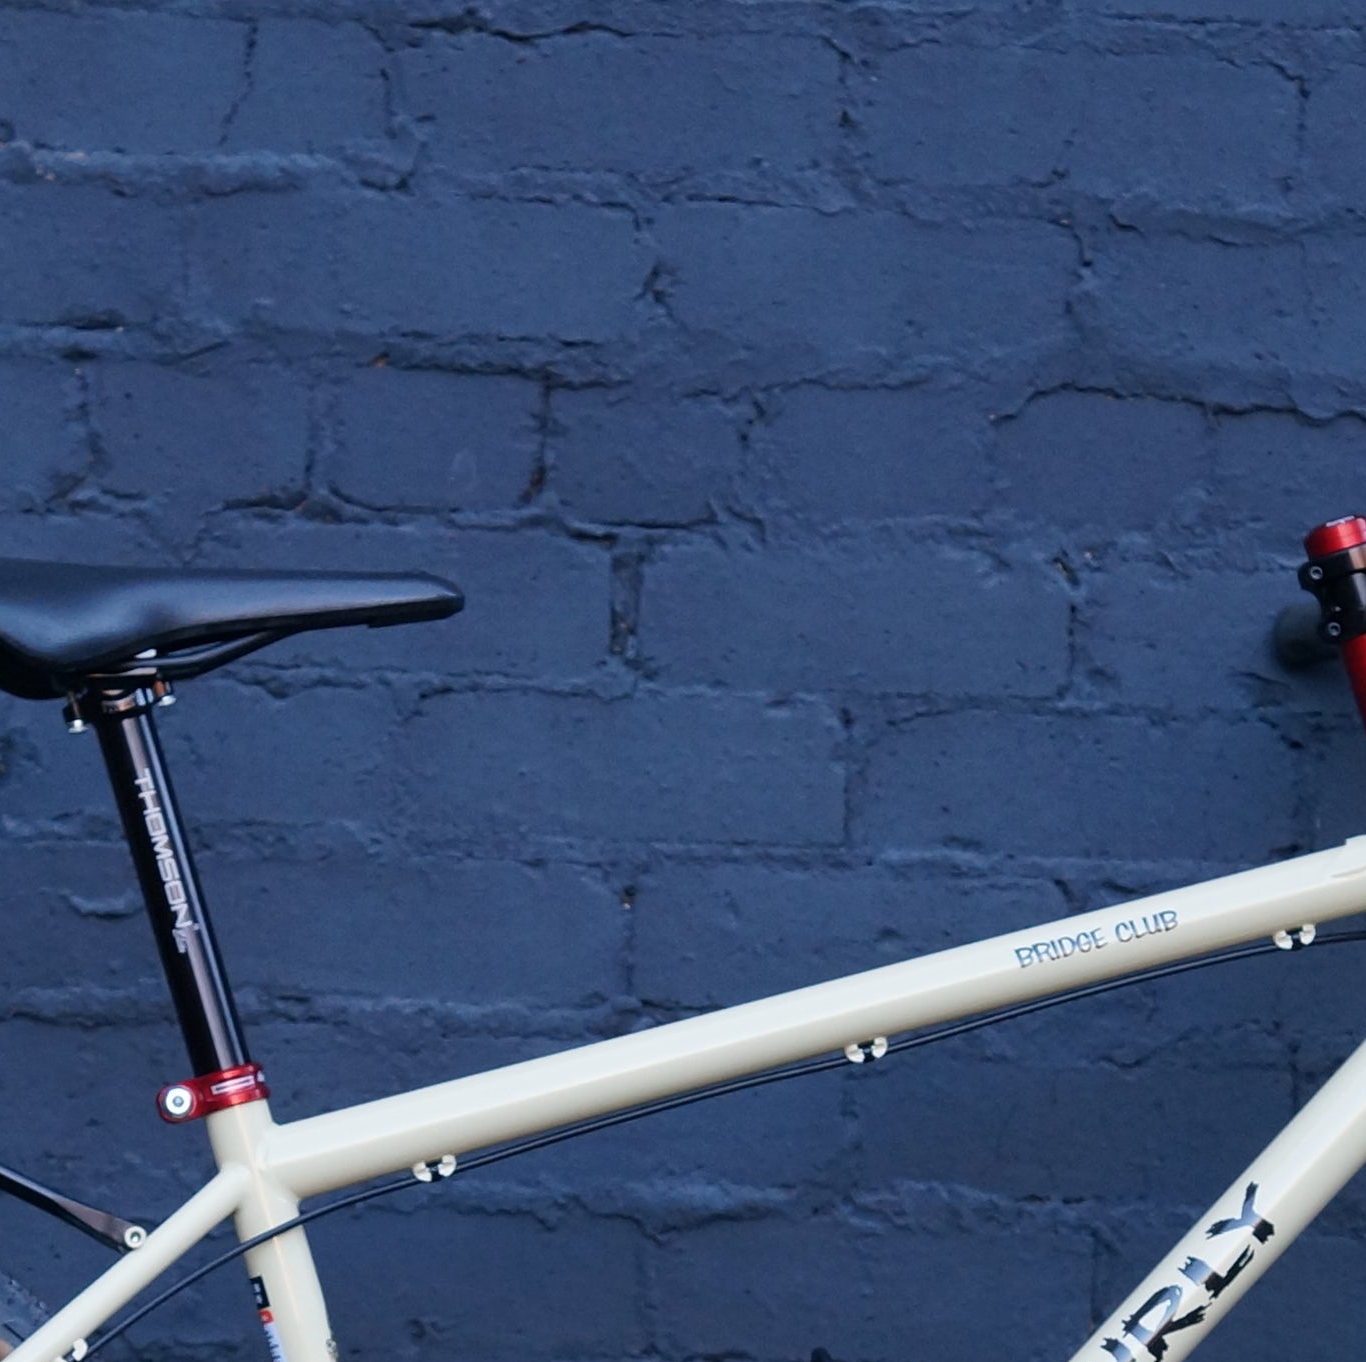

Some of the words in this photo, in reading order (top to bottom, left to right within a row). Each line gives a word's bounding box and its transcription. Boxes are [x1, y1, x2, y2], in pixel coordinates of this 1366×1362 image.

[134, 767, 193, 931] THOMSON
[1013, 927, 1108, 969] BRIDGE
[1114, 909, 1180, 944] CLUB
